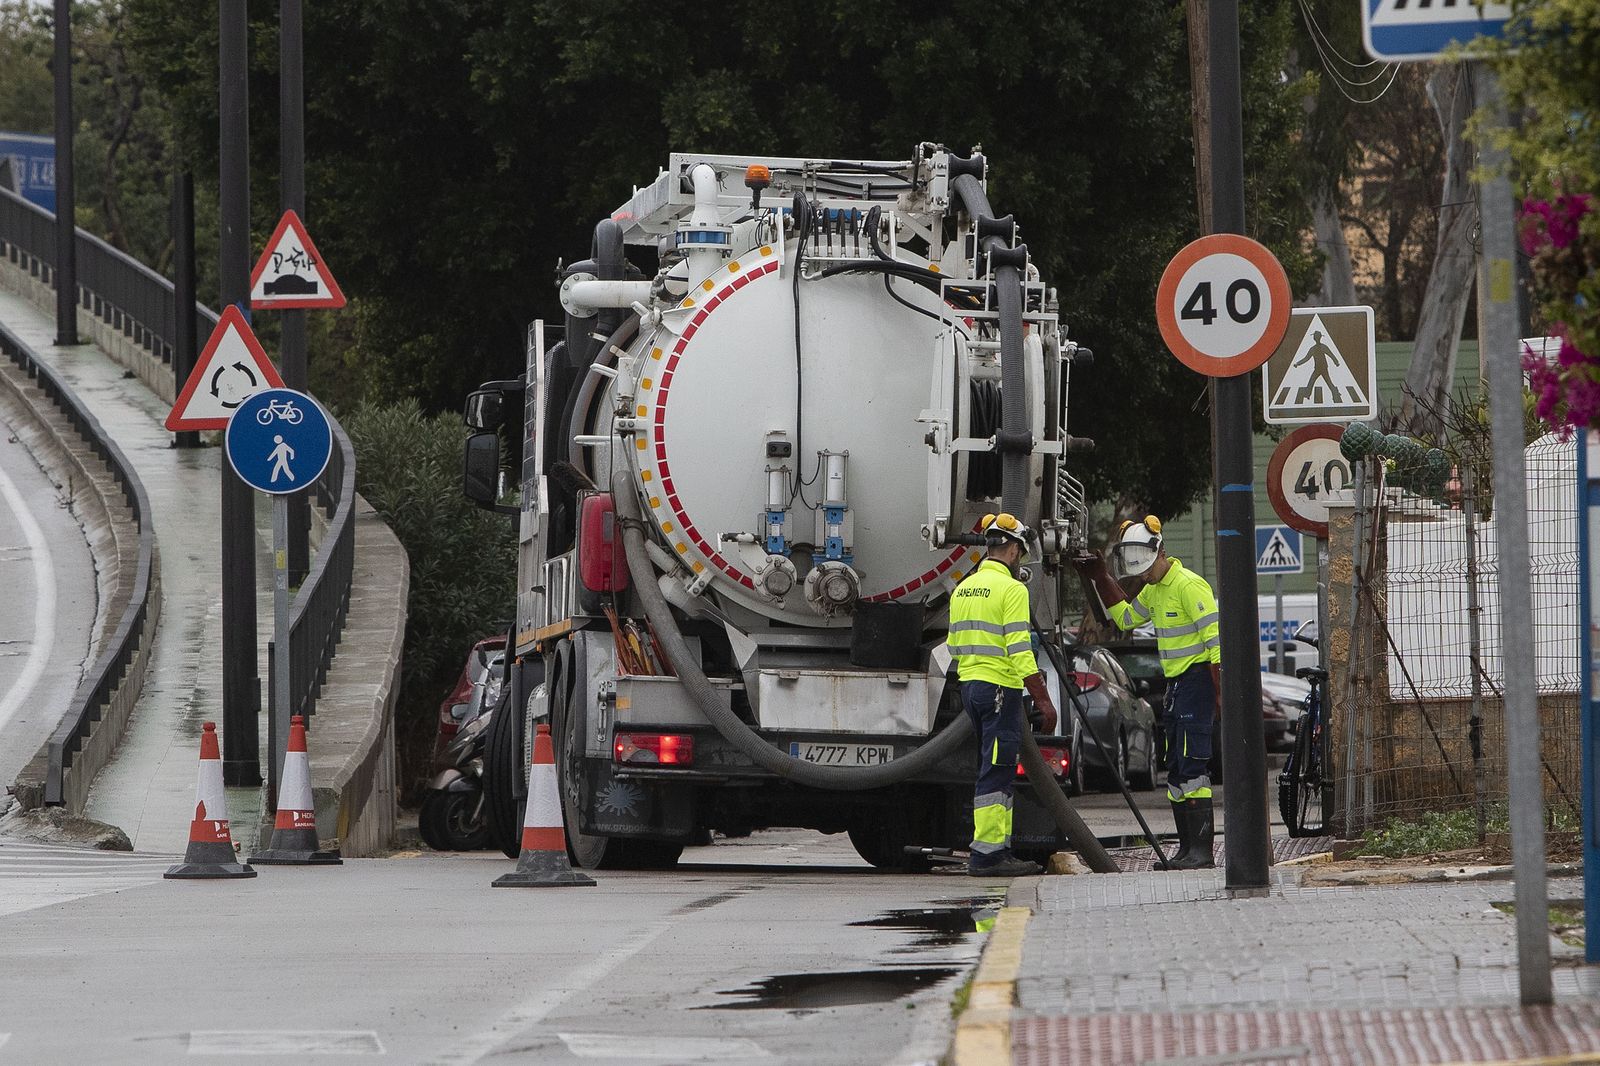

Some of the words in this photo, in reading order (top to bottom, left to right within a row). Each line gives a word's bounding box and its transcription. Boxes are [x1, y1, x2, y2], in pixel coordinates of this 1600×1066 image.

[1180, 278, 1261, 325] 40
[1294, 459, 1350, 500] 40
[805, 745, 848, 763] 4777
[856, 747, 889, 764] KPW
